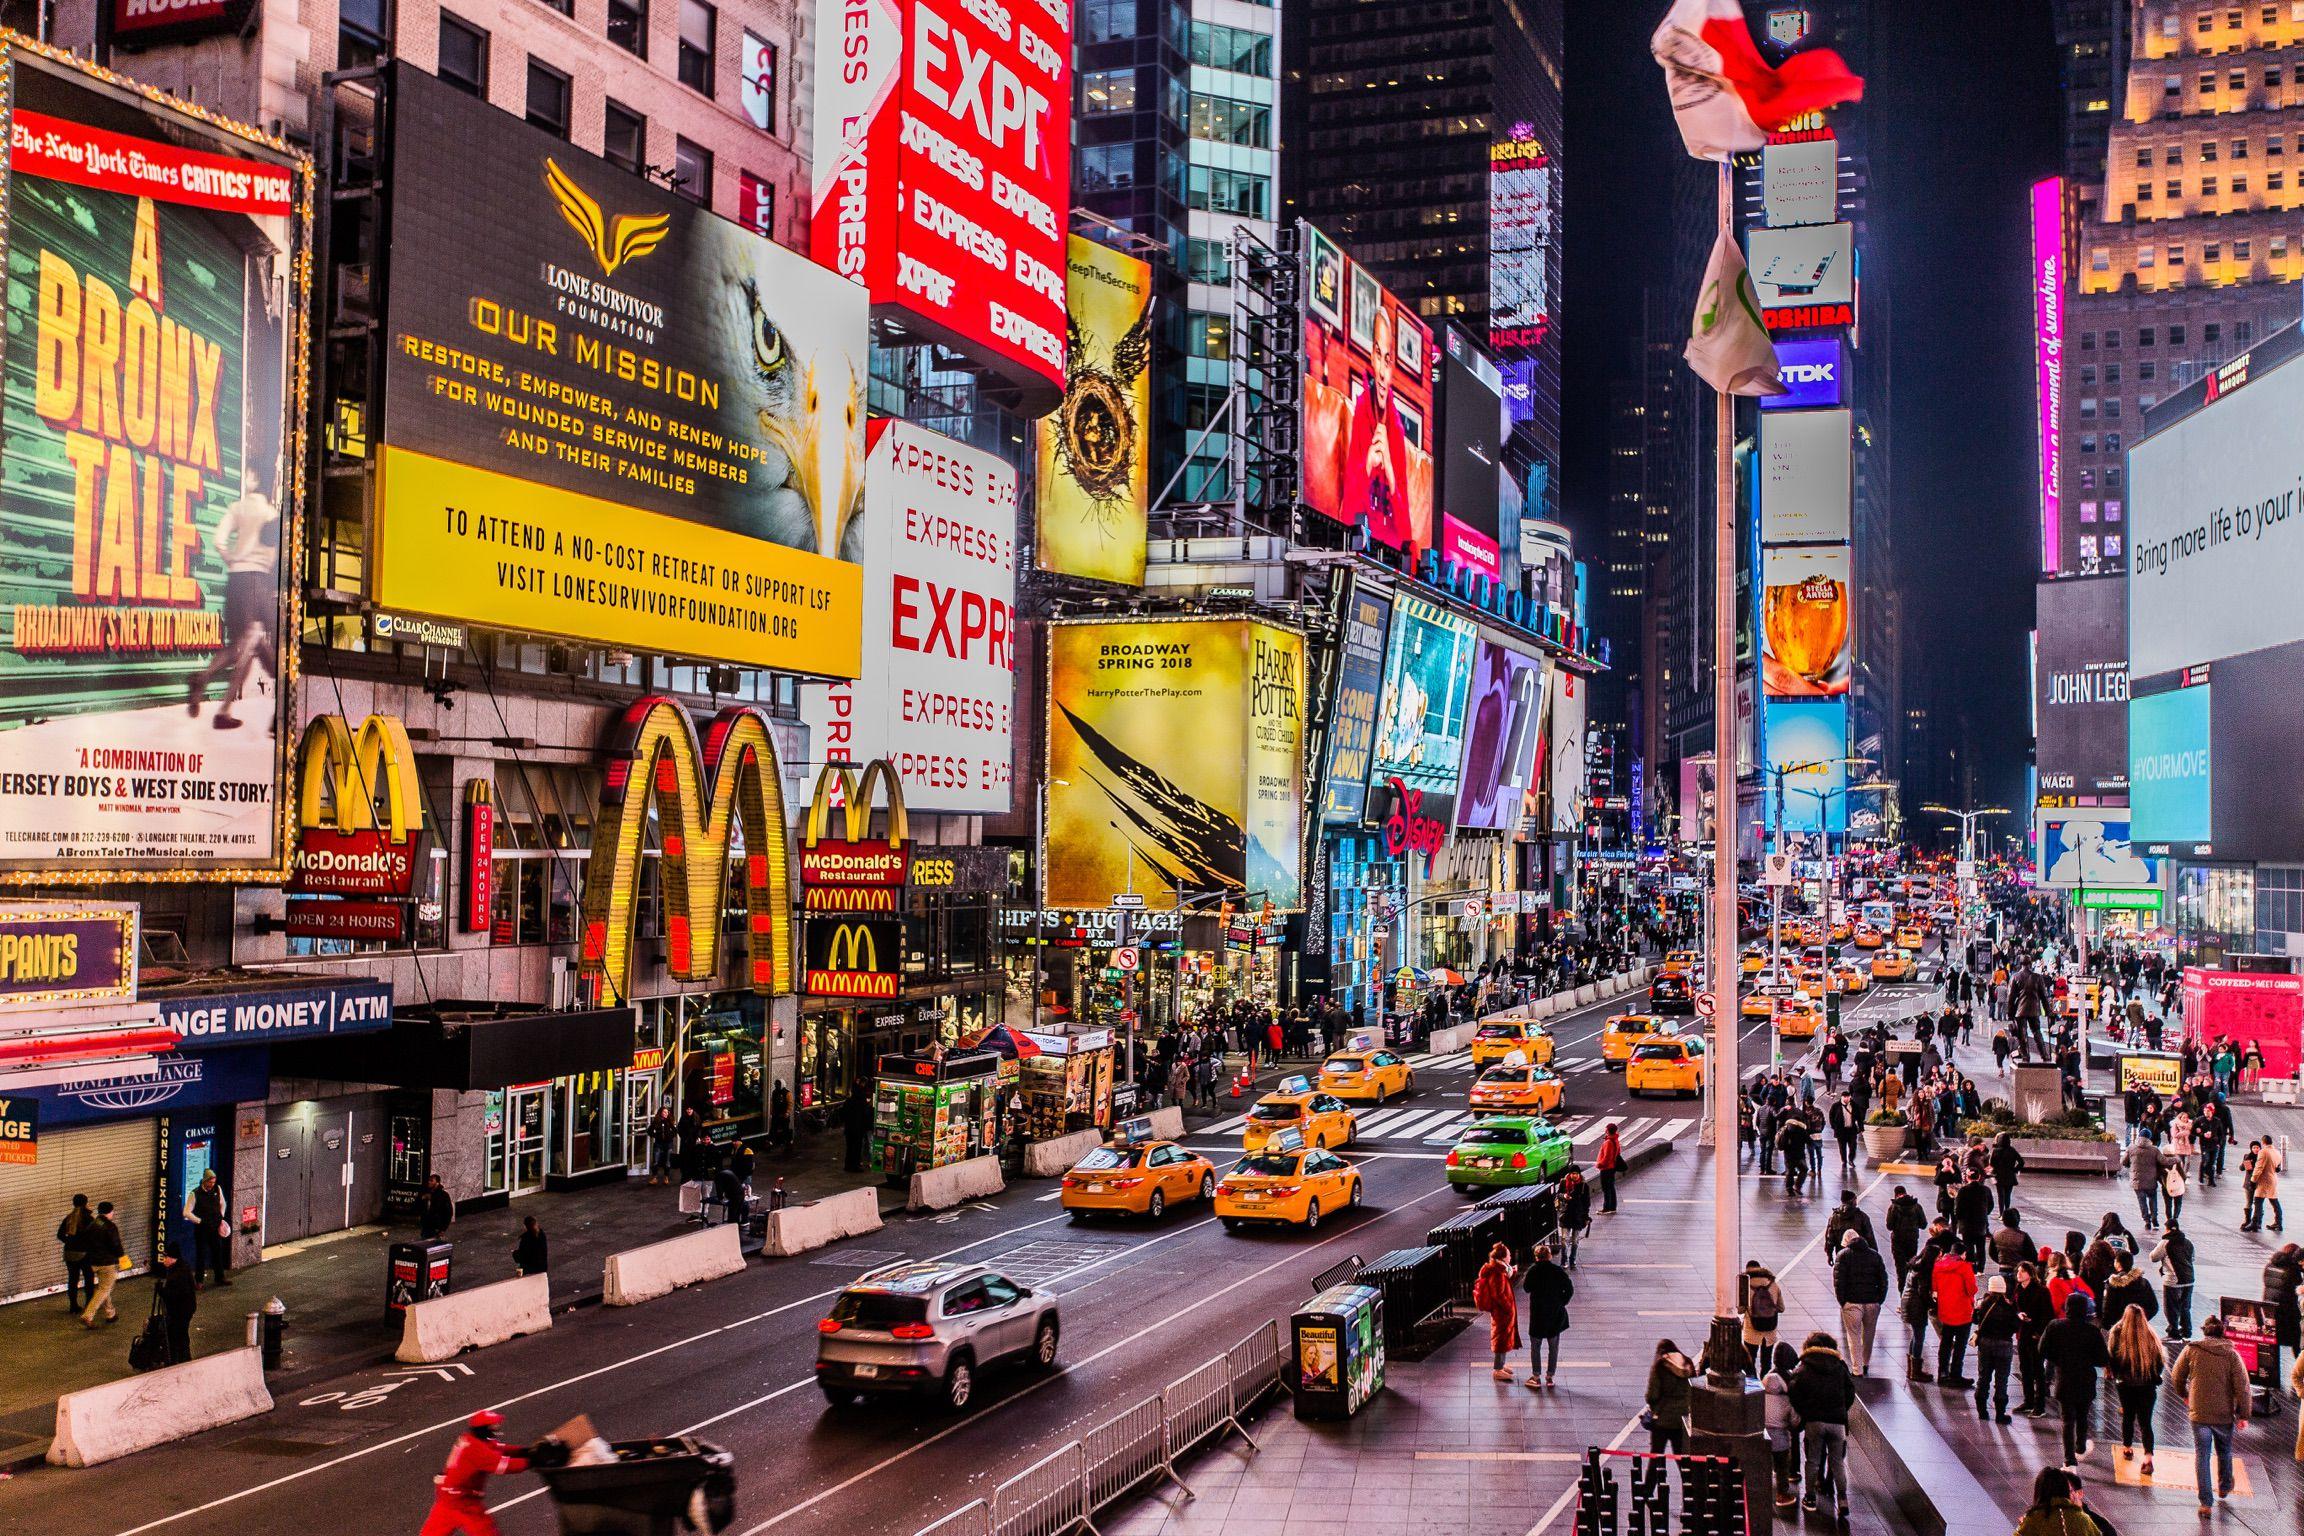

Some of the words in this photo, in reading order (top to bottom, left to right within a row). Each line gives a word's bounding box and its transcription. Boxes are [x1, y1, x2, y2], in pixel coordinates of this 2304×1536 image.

[1768, 126, 1835, 145] TOSHIBA
[11, 123, 43, 153] The
[45, 133, 83, 165] New
[86, 142, 129, 174] York
[129, 151, 179, 186] Times
[181, 163, 252, 199] CRITICS'
[253, 175, 292, 203] PICK
[914, 189, 1008, 271] EXPRESS
[129, 196, 161, 306] A
[547, 263, 588, 296] LONE
[591, 278, 664, 328] SURVIVOR
[2039, 254, 2057, 335] sunshine.
[557, 296, 655, 345] FOUNDATION
[1761, 305, 1852, 330] OSHIBA
[35, 248, 222, 474] BRONX
[474, 298, 558, 356] OUR
[576, 333, 721, 412] MISSION
[1782, 363, 1834, 384] TDK
[402, 335, 511, 388] RESTORE,
[519, 372, 619, 420] EMPOWER,
[625, 406, 662, 431] AND
[668, 417, 723, 454] RENEW
[728, 439, 769, 466] HOPE
[434, 376, 478, 407] FOR
[486, 391, 584, 438] WOUNDED
[592, 423, 667, 463] SERVICE
[672, 446, 749, 486] MEMBERS
[506, 431, 549, 457] AND
[555, 440, 610, 474] THEIR
[617, 458, 696, 496] FAMILIES
[65, 430, 205, 604] TALE
[906, 507, 998, 564] EXPRESS
[2136, 538, 2167, 575] Bring
[2171, 525, 2206, 562] more
[2210, 506, 2231, 547] life
[2235, 505, 2251, 537] to
[2255, 489, 2293, 541] your
[445, 506, 468, 537] TO
[476, 513, 546, 552] ATTEND
[554, 530, 564, 556] A
[572, 535, 645, 574] NO-COST
[652, 552, 715, 588] RETREAT
[722, 568, 739, 592] OR
[745, 572, 805, 608] SUPPORT
[809, 584, 831, 612] LSF
[497, 561, 545, 597] VISIT
[552, 569, 798, 640] LONESURVIVORFOUNDATION.ORG
[1212, 587, 1252, 598] LAMAR
[1805, 584, 1833, 594] STELLA
[1805, 591, 1834, 600] ARTOIS
[13, 604, 117, 650] BROADWAY'S
[119, 606, 150, 648] NEW
[151, 611, 173, 647] HIT
[174, 610, 223, 648] MUSICAL
[1097, 657, 1155, 671] SPRING
[1160, 656, 1193, 670] 2018
[1100, 643, 1192, 656] BROADWAY
[1255, 638, 1299, 685] HARRY
[1087, 686, 1203, 701] HarryPotterThePlay.com
[1251, 674, 1300, 722] POTTER
[2049, 672, 2092, 705] JOHN
[902, 688, 994, 732] EXPRESS
[1340, 686, 1376, 722] COME
[1255, 725, 1277, 742] CURSED
[1277, 729, 1295, 745] CHILD
[1335, 716, 1372, 752] FROM
[92, 749, 185, 774] COMBINATION
[188, 753, 204, 774] OF
[1331, 747, 1369, 781] AWAY
[2134, 749, 2208, 782] #YOURMOVE
[0, 773, 59, 798] ERSEY
[64, 775, 111, 798] BOYS
[114, 777, 127, 798] &
[132, 778, 178, 800] WEST
[181, 780, 216, 801] SIDE
[1258, 775, 1290, 788] BROADWAY
[1258, 789, 1278, 801] SPRING
[2041, 775, 2074, 789] WACO
[98, 803, 113, 813] MATT
[5, 831, 69, 843] TELECHARGE.COM
[70, 832, 80, 843] OR
[145, 833, 178, 844] LONGACRE
[209, 835, 221, 845] 220
[480, 810, 488, 855] OPEN
[57, 847, 214, 858] ABronxTaleTheMusical.com
[293, 850, 407, 874] McDonald's
[477, 858, 489, 868] 24
[803, 854, 902, 870] McDonald's
[305, 874, 386, 889] Restaurant
[820, 870, 885, 881] Restaurant
[912, 859, 955, 887] RESS
[477, 871, 487, 926] HOURS
[289, 914, 325, 928] OPEN
[329, 914, 345, 928] 24
[349, 914, 396, 930] HOURS
[1085, 928, 1106, 939] NY
[1054, 938, 1083, 946] Canon
[0, 933, 78, 980] PANTS
[2208, 977, 2252, 988] COFFEED
[235, 1000, 326, 1031] MONEY
[339, 996, 389, 1022] ATM
[876, 1014, 905, 1028] EXPRESS
[918, 1007, 946, 1022] EXPRESS
[2124, 1068, 2177, 1083] Beautiful
[160, 1117, 170, 1170] MONEY
[185, 1126, 216, 1139] CHANGE
[158, 1177, 171, 1264] EXCHANGE
[1300, 1329, 1335, 1340] Beautiful
